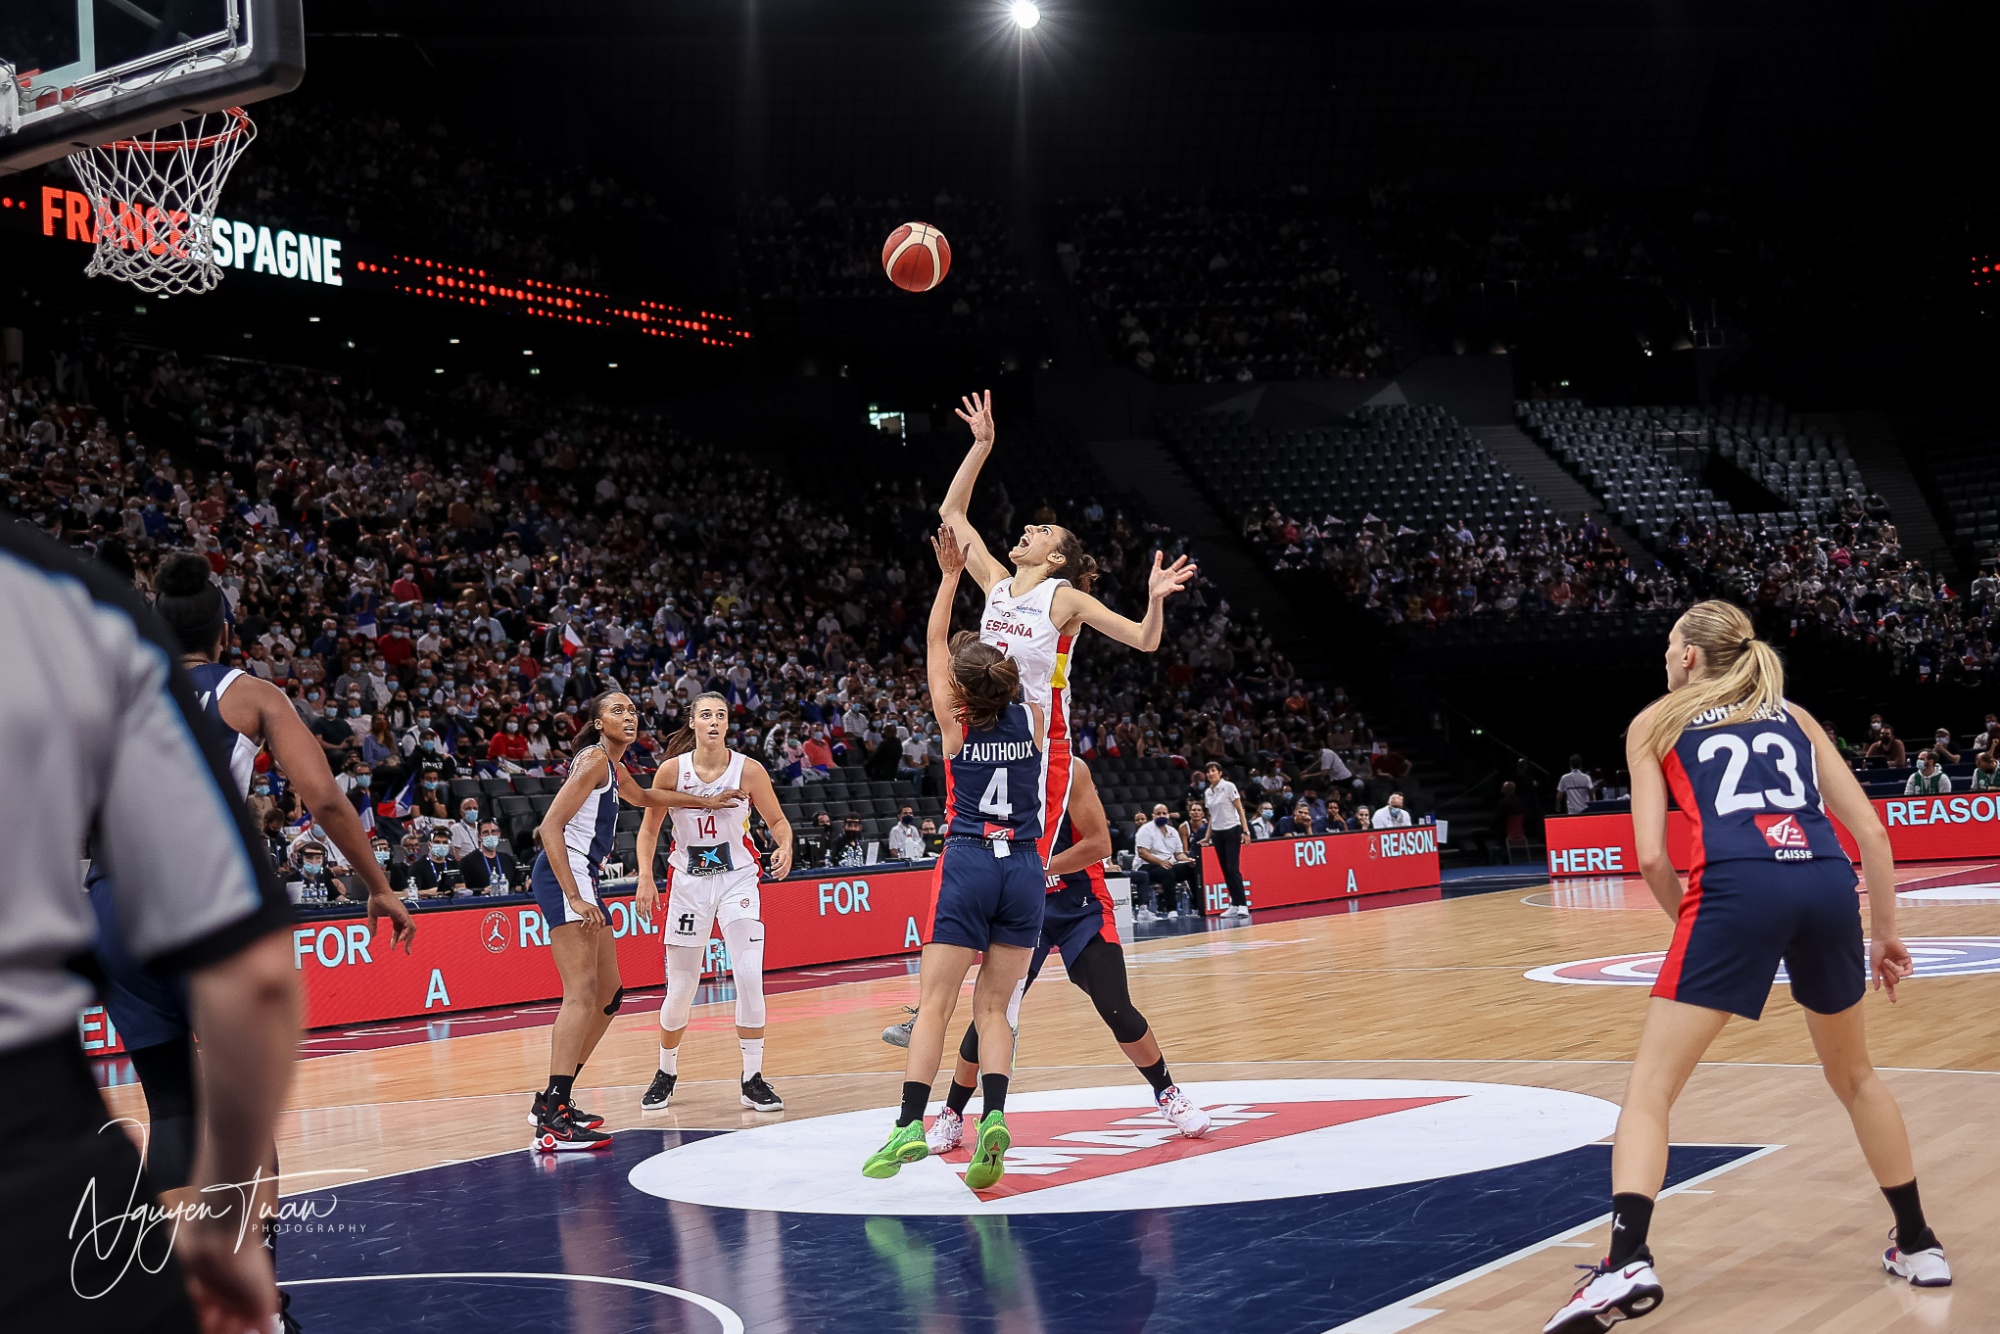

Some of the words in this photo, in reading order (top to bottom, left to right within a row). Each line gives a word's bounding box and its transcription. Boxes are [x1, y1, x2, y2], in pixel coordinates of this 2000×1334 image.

[42, 186, 190, 260] FRANCE
[188, 213, 343, 287] ESPAGNE
[985, 619, 1033, 639] ESPAÑA
[962, 740, 1034, 762] FAUTHOUX
[1697, 731, 1808, 818] 23
[978, 767, 1013, 821] 4
[1886, 795, 2000, 826] REASO
[697, 815, 717, 839] 14
[1294, 840, 1327, 868] FOR
[1380, 830, 1437, 858] REASON.
[1775, 849, 1814, 860] CAISSE
[1549, 846, 1624, 874] HERE
[1346, 868, 1359, 893] A
[818, 880, 871, 916] FOR
[1205, 881, 1252, 911] HEE
[293, 924, 374, 970] FOR
[904, 916, 921, 948] A
[424, 968, 451, 1009] A
